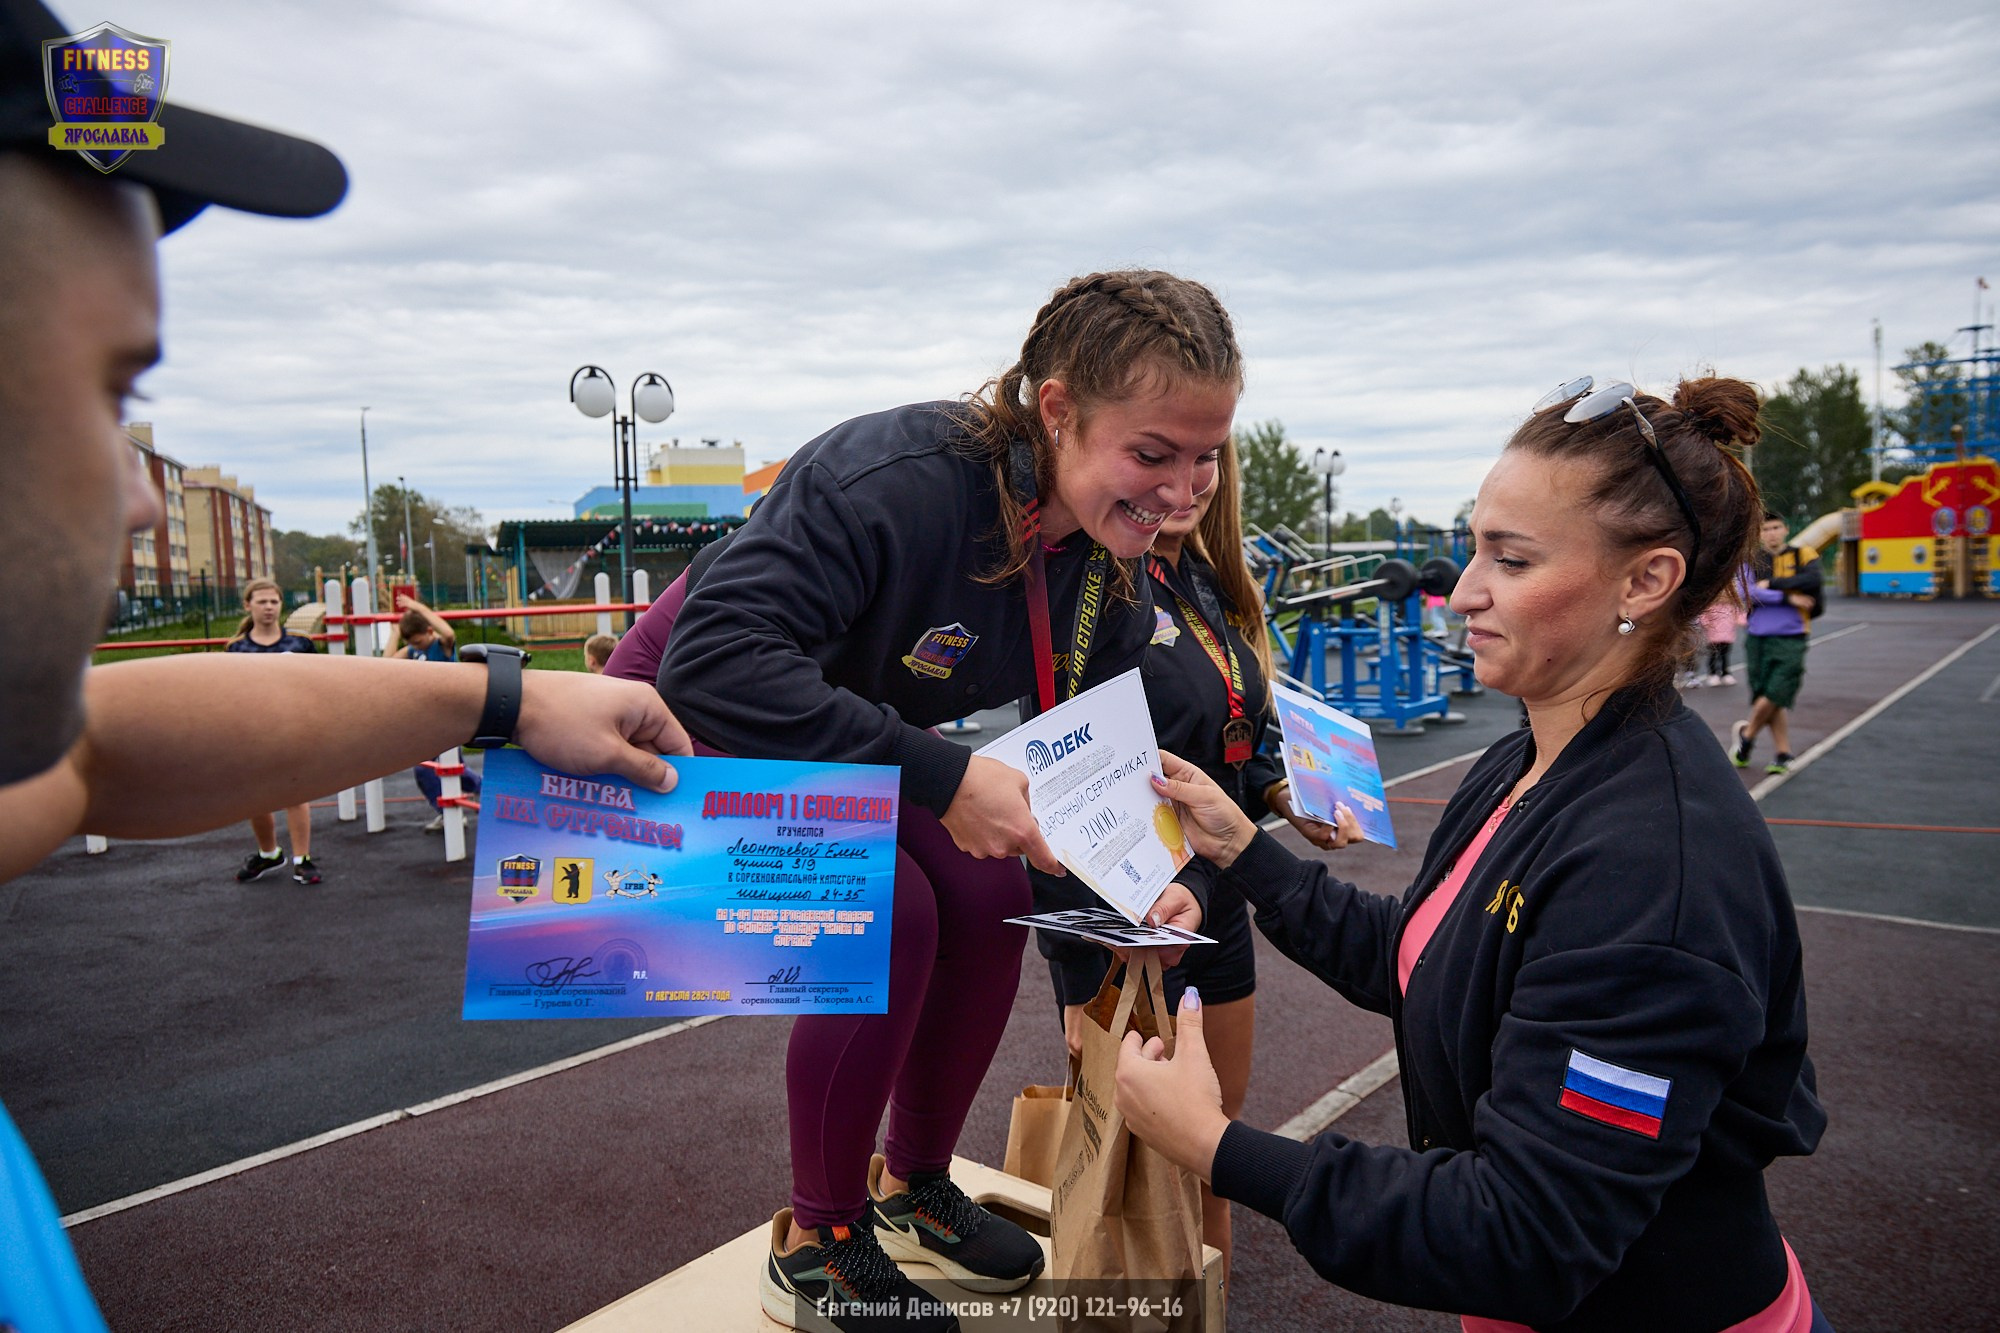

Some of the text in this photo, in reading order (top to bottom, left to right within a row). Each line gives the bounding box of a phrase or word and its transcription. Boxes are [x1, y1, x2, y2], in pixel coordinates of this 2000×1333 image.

[1089, 550, 1106, 561] 24
[1077, 571, 1102, 649] СТРЕЛКЕ
[931, 633, 969, 648] FITNESS
[1073, 650, 1085, 677] НА
[540, 773, 636, 810] БИТВА
[1040, 791, 1087, 838] ДАРОЧНЫЙ
[1085, 751, 1149, 802] СЕРТИФИКАТ
[702, 791, 782, 819] ДИПЛОМ
[803, 795, 892, 822] СТЕПЕНИ
[494, 794, 684, 848] НА СТРЕЛКЕ!
[777, 826, 824, 838] ВРУЧАЕТСЯ
[504, 861, 536, 871] FITNESS
[728, 872, 867, 885] В СОРЕВНОВАТЕЛЬНОЙ КАТЕГОРИИ
[624, 882, 644, 890] IFBB
[821, 888, 865, 900] 24-35
[716, 908, 874, 923] НА 1-ОМ КУБКЕ ЯРОСЛАВСКОЙ ОБЛАСТИ
[724, 921, 736, 934] ПО
[737, 922, 820, 935] ФИТНЕС-ЧЕЛЛЕНДЖ
[853, 923, 865, 935] НА
[489, 987, 531, 996] Главный
[561, 987, 626, 997] соревнований
[645, 990, 654, 1001] 17
[655, 990, 690, 1001] АВГУСТА
[691, 990, 710, 1001] 2024
[769, 985, 849, 995] Главный секретарь
[534, 999, 572, 1010] Гурьева
[573, 998, 594, 1007] О.Г.
[741, 996, 800, 1006] соревнований
[814, 995, 854, 1005] Кокорева
[856, 995, 874, 1004] А.С.
